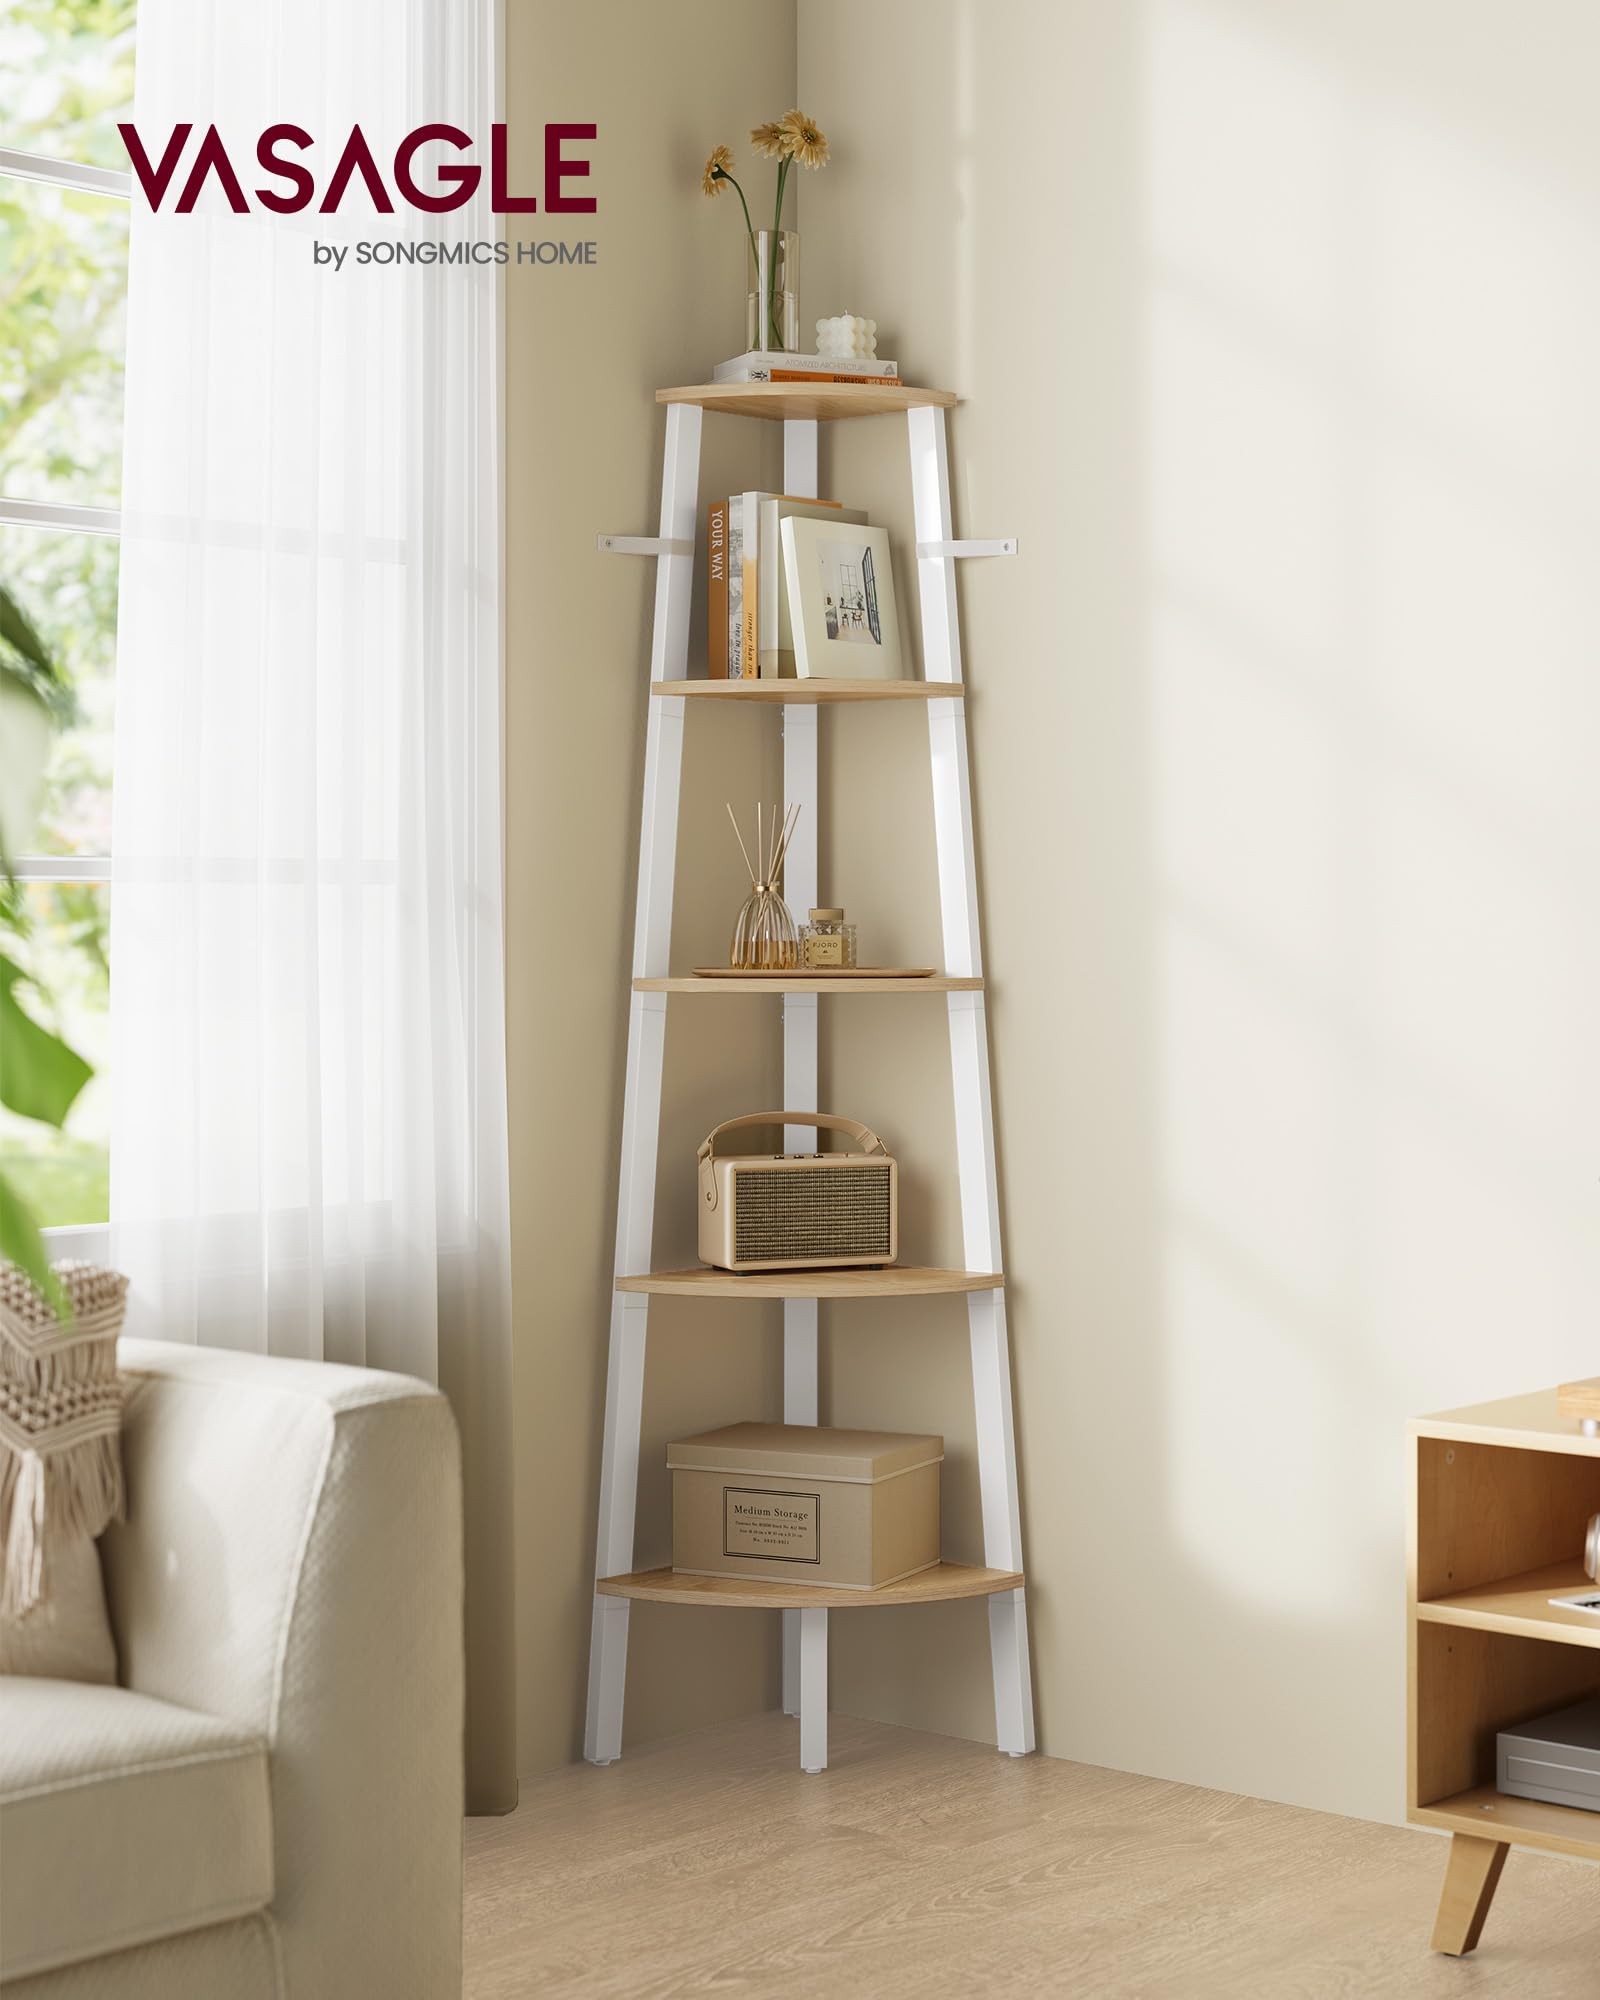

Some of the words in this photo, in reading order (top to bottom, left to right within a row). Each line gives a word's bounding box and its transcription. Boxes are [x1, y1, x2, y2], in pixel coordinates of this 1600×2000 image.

[711, 509, 723, 550] YOUR
[711, 552, 723, 581] WAY
[734, 1505, 771, 1516] Medium
[774, 1508, 809, 1521] Storage
